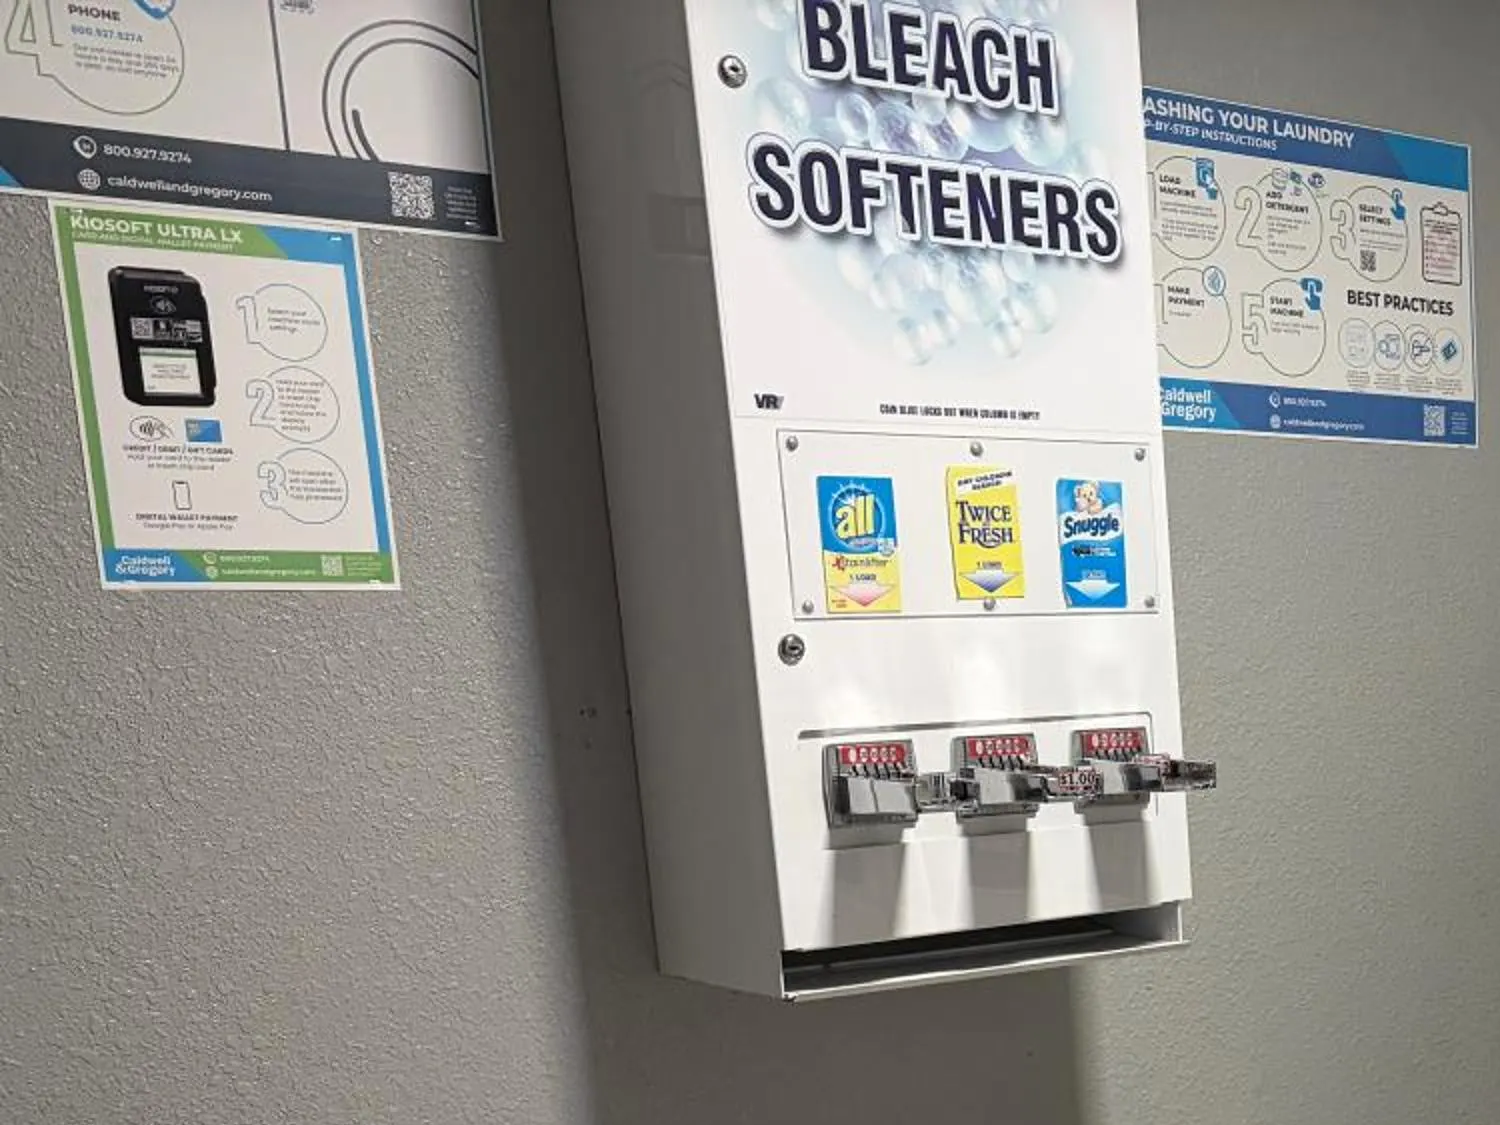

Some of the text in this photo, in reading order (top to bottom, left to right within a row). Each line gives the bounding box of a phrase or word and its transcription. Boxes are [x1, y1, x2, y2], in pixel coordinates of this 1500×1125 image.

[68, 4, 121, 22] PHONE
[801, 0, 1057, 113] BLEACH
[1142, 96, 1355, 149] ASHING YOUR LAUNDRY
[1144, 118, 1278, 151] P-BY-STEP INSTRUCTIONS
[103, 144, 193, 164] 800.927.9274
[107, 175, 273, 201] caldwellandgregory.com
[750, 140, 1121, 260] SOFTENERS
[71, 216, 243, 244] KIOSOFT ULTRA LX
[1346, 289, 1454, 316] BEST PRACTICES
[1161, 387, 1211, 404] aldwell
[835, 494, 875, 539] all
[956, 500, 1012, 522] TWICE
[957, 522, 1013, 548] FRESH
[1064, 514, 1120, 538] Snuggle
[1059, 772, 1096, 786] $1.00
